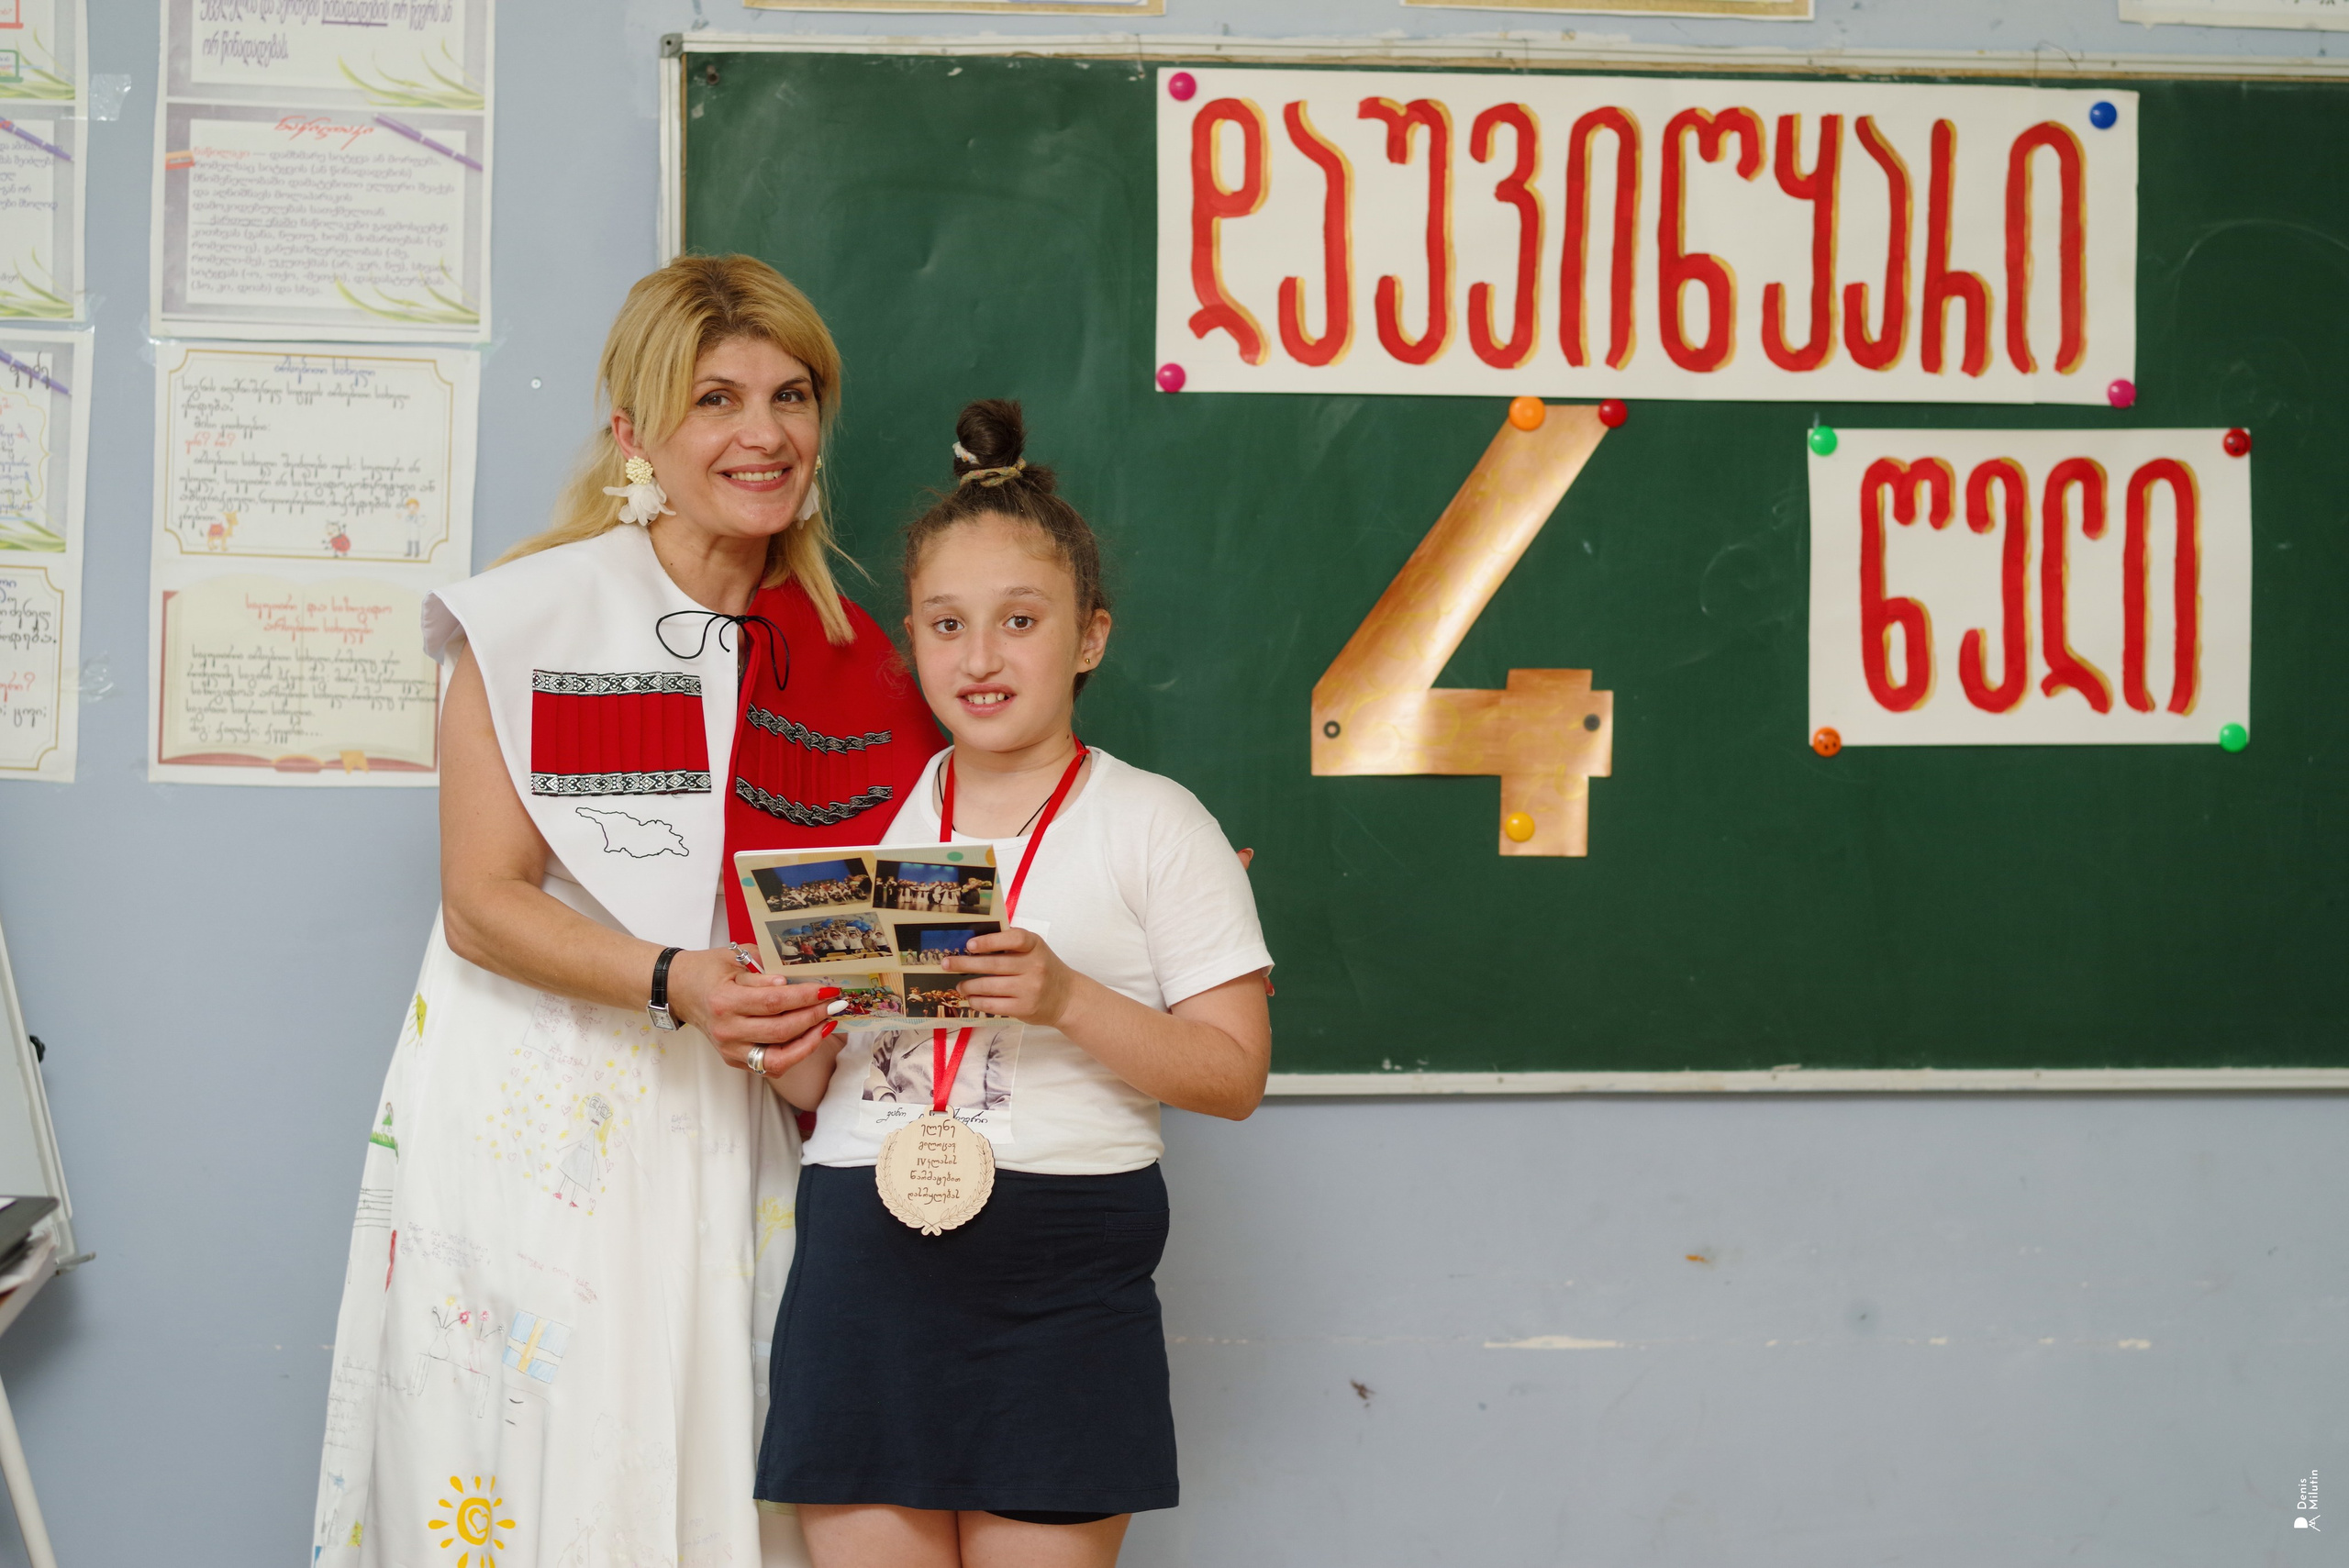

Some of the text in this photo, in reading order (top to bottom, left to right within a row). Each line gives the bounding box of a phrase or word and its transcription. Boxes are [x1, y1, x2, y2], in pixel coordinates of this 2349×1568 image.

[202, 30, 219, 56] ორ
[193, 188, 209, 199] და
[1187, 95, 2087, 377] დაუვიწყარი
[1859, 456, 2202, 716] წელი
[244, 592, 297, 619] საკუთარი
[306, 602, 328, 618] და
[1311, 404, 1627, 859] 4
[921, 1119, 956, 1139] ელენე
[918, 1141, 956, 1153] გილოცავ
[910, 1170, 962, 1186] წარმატებით
[907, 1187, 961, 1206] დასრულებას
